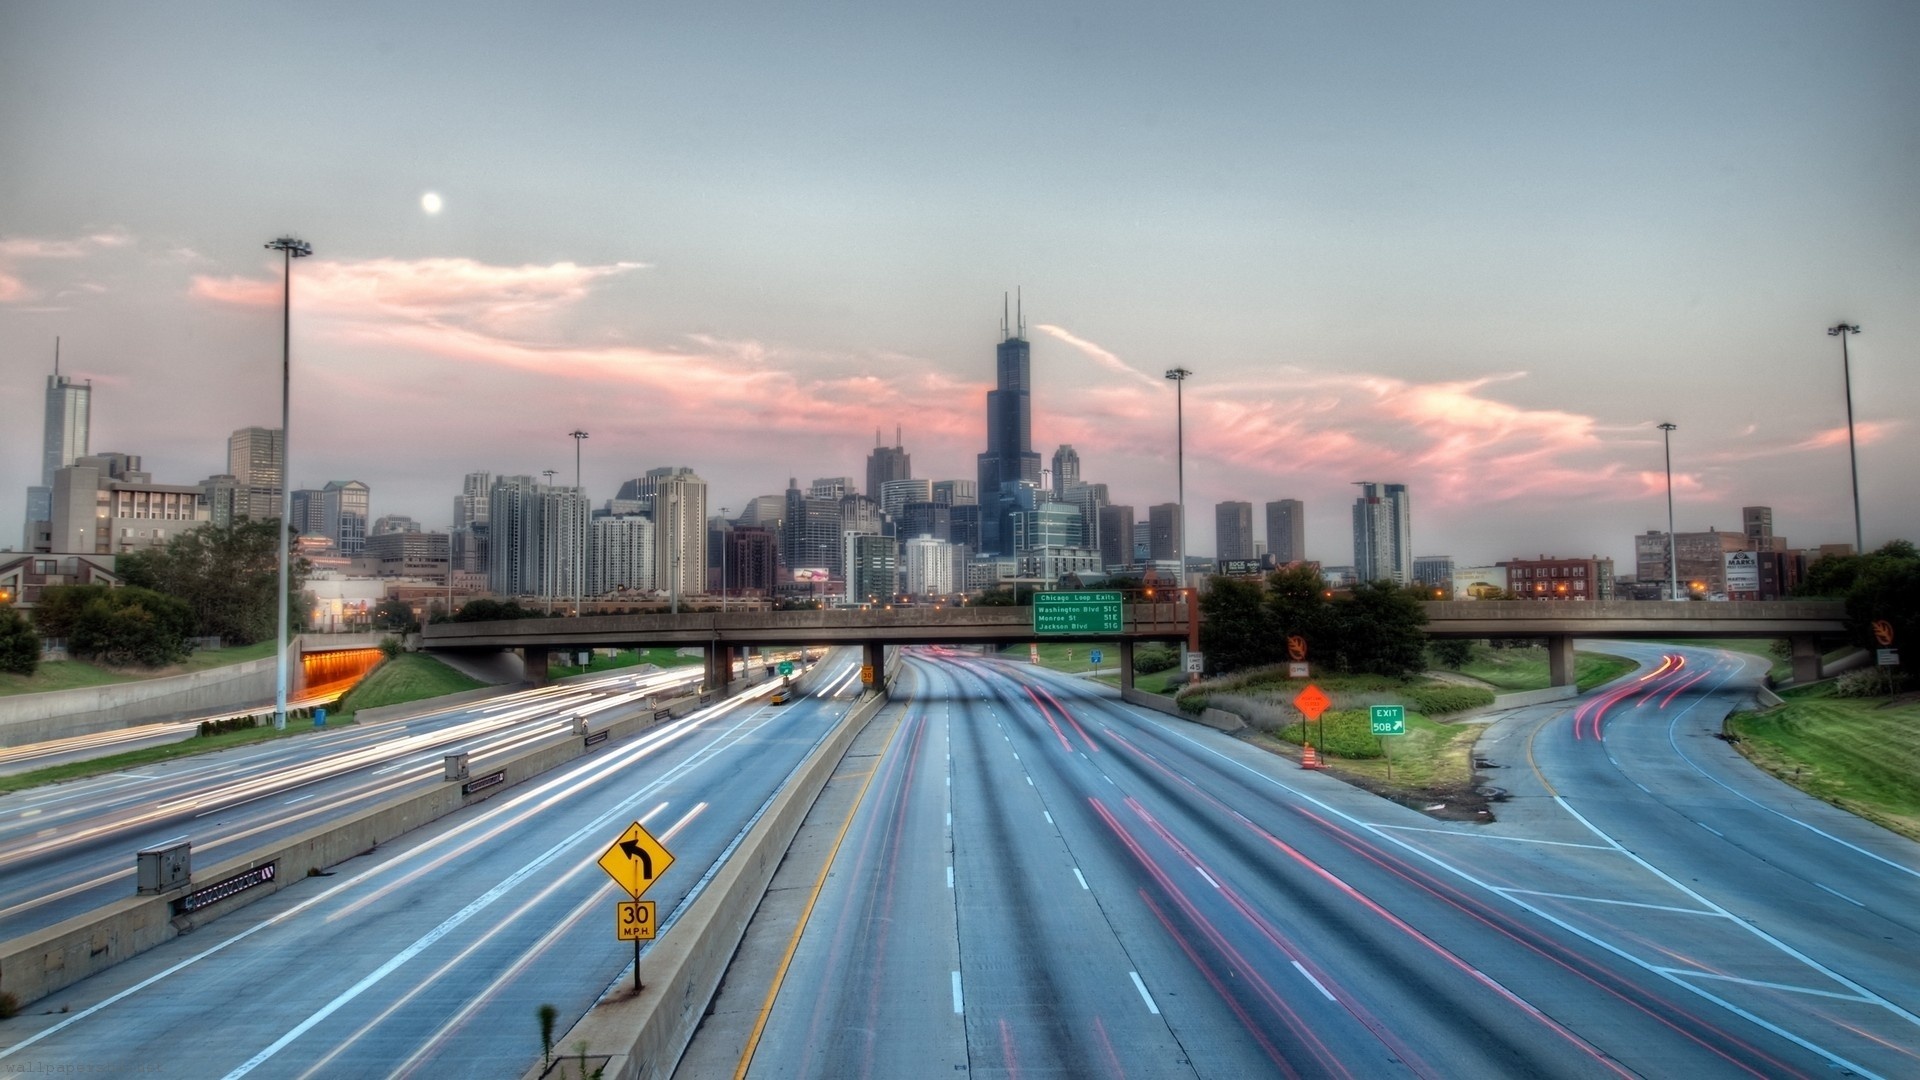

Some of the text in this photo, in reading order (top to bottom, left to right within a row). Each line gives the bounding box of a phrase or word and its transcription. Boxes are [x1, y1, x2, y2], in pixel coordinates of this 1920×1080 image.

[1040, 594, 1070, 603] Chicago
[1074, 594, 1091, 602] Loop
[1038, 606, 1080, 614] Washington
[1103, 605, 1118, 613] 51C
[1189, 663, 1201, 671] 45
[1376, 709, 1398, 717] EXIT
[1373, 722, 1392, 732] 50B
[623, 906, 648, 924] 30
